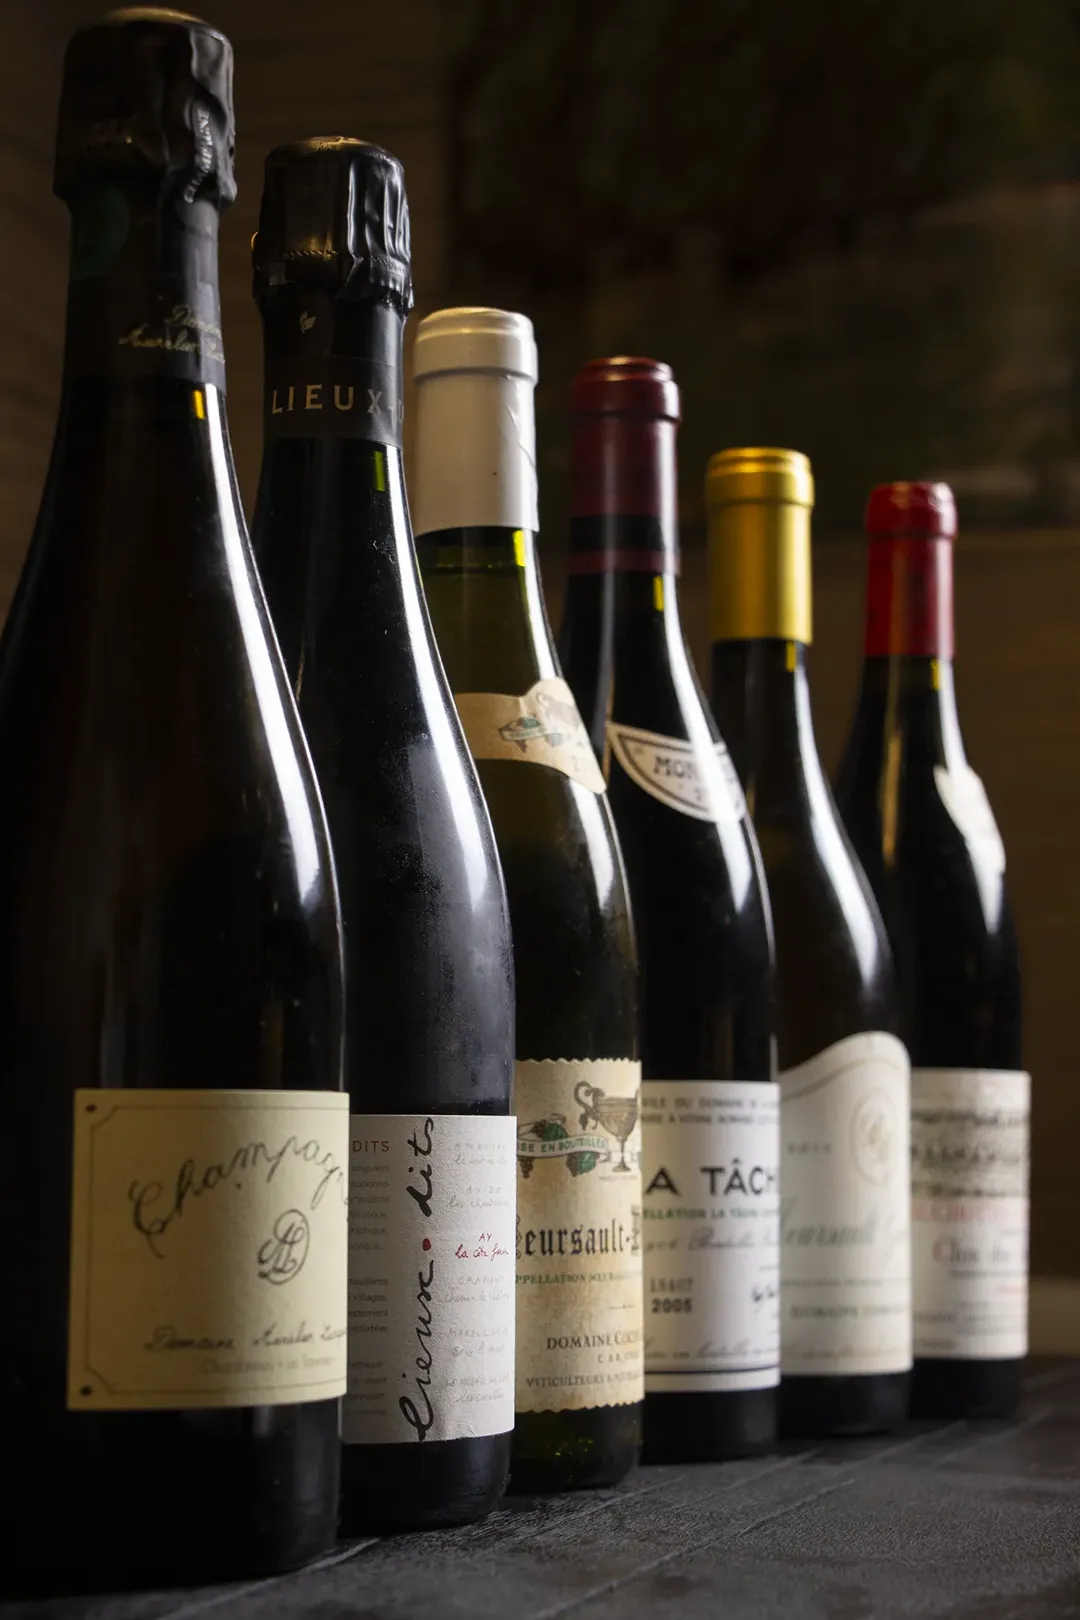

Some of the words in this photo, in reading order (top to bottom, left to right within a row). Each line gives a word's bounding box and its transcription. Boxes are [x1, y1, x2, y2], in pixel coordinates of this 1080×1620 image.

[352, 1140, 390, 1153] DITS
[518, 1141, 535, 1153] SE
[516, 1207, 640, 1259] eursault-
[651, 1297, 693, 1314] 2005
